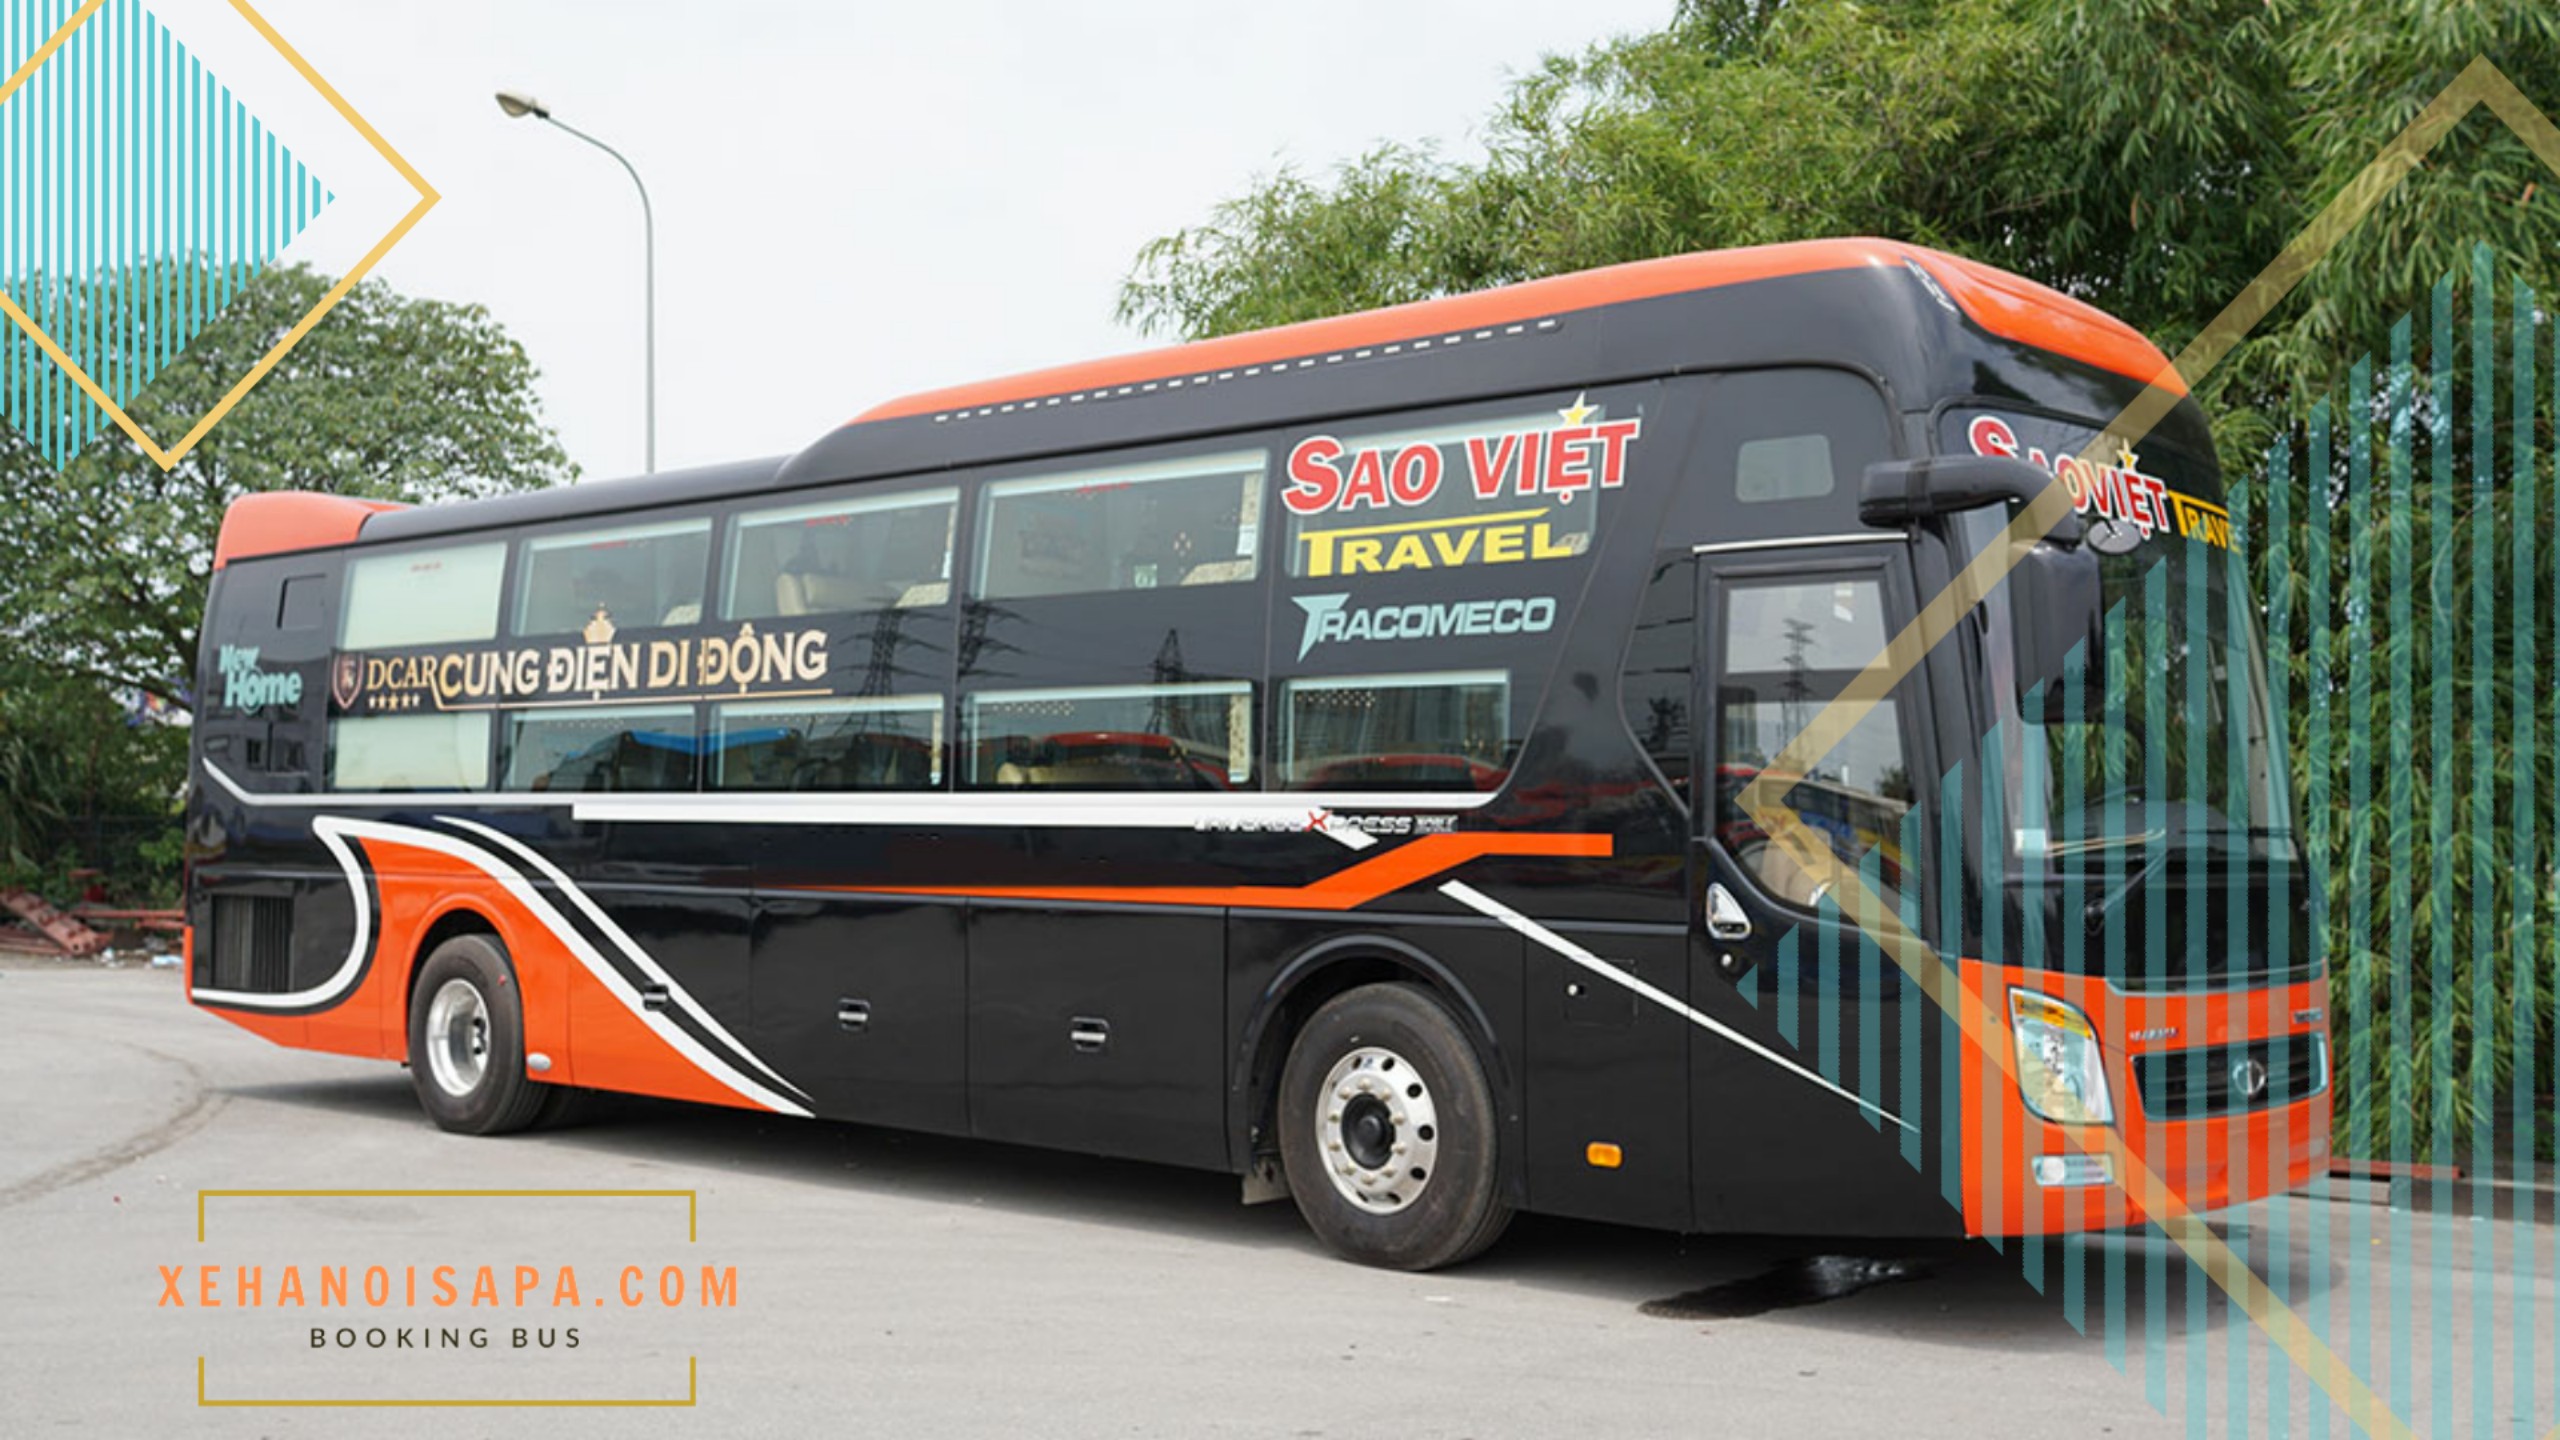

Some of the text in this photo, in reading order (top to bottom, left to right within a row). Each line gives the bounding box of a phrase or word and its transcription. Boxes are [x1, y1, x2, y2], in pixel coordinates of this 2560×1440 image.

[1281, 435, 1443, 514] SAO
[1298, 507, 1573, 577] TRAVEL
[218, 644, 260, 674] New
[438, 649, 541, 698] CUNG
[647, 639, 691, 690] DI
[697, 621, 829, 695] ĐỘNG
[1291, 593, 1556, 662] TRACOMECO
[224, 671, 303, 714] Home
